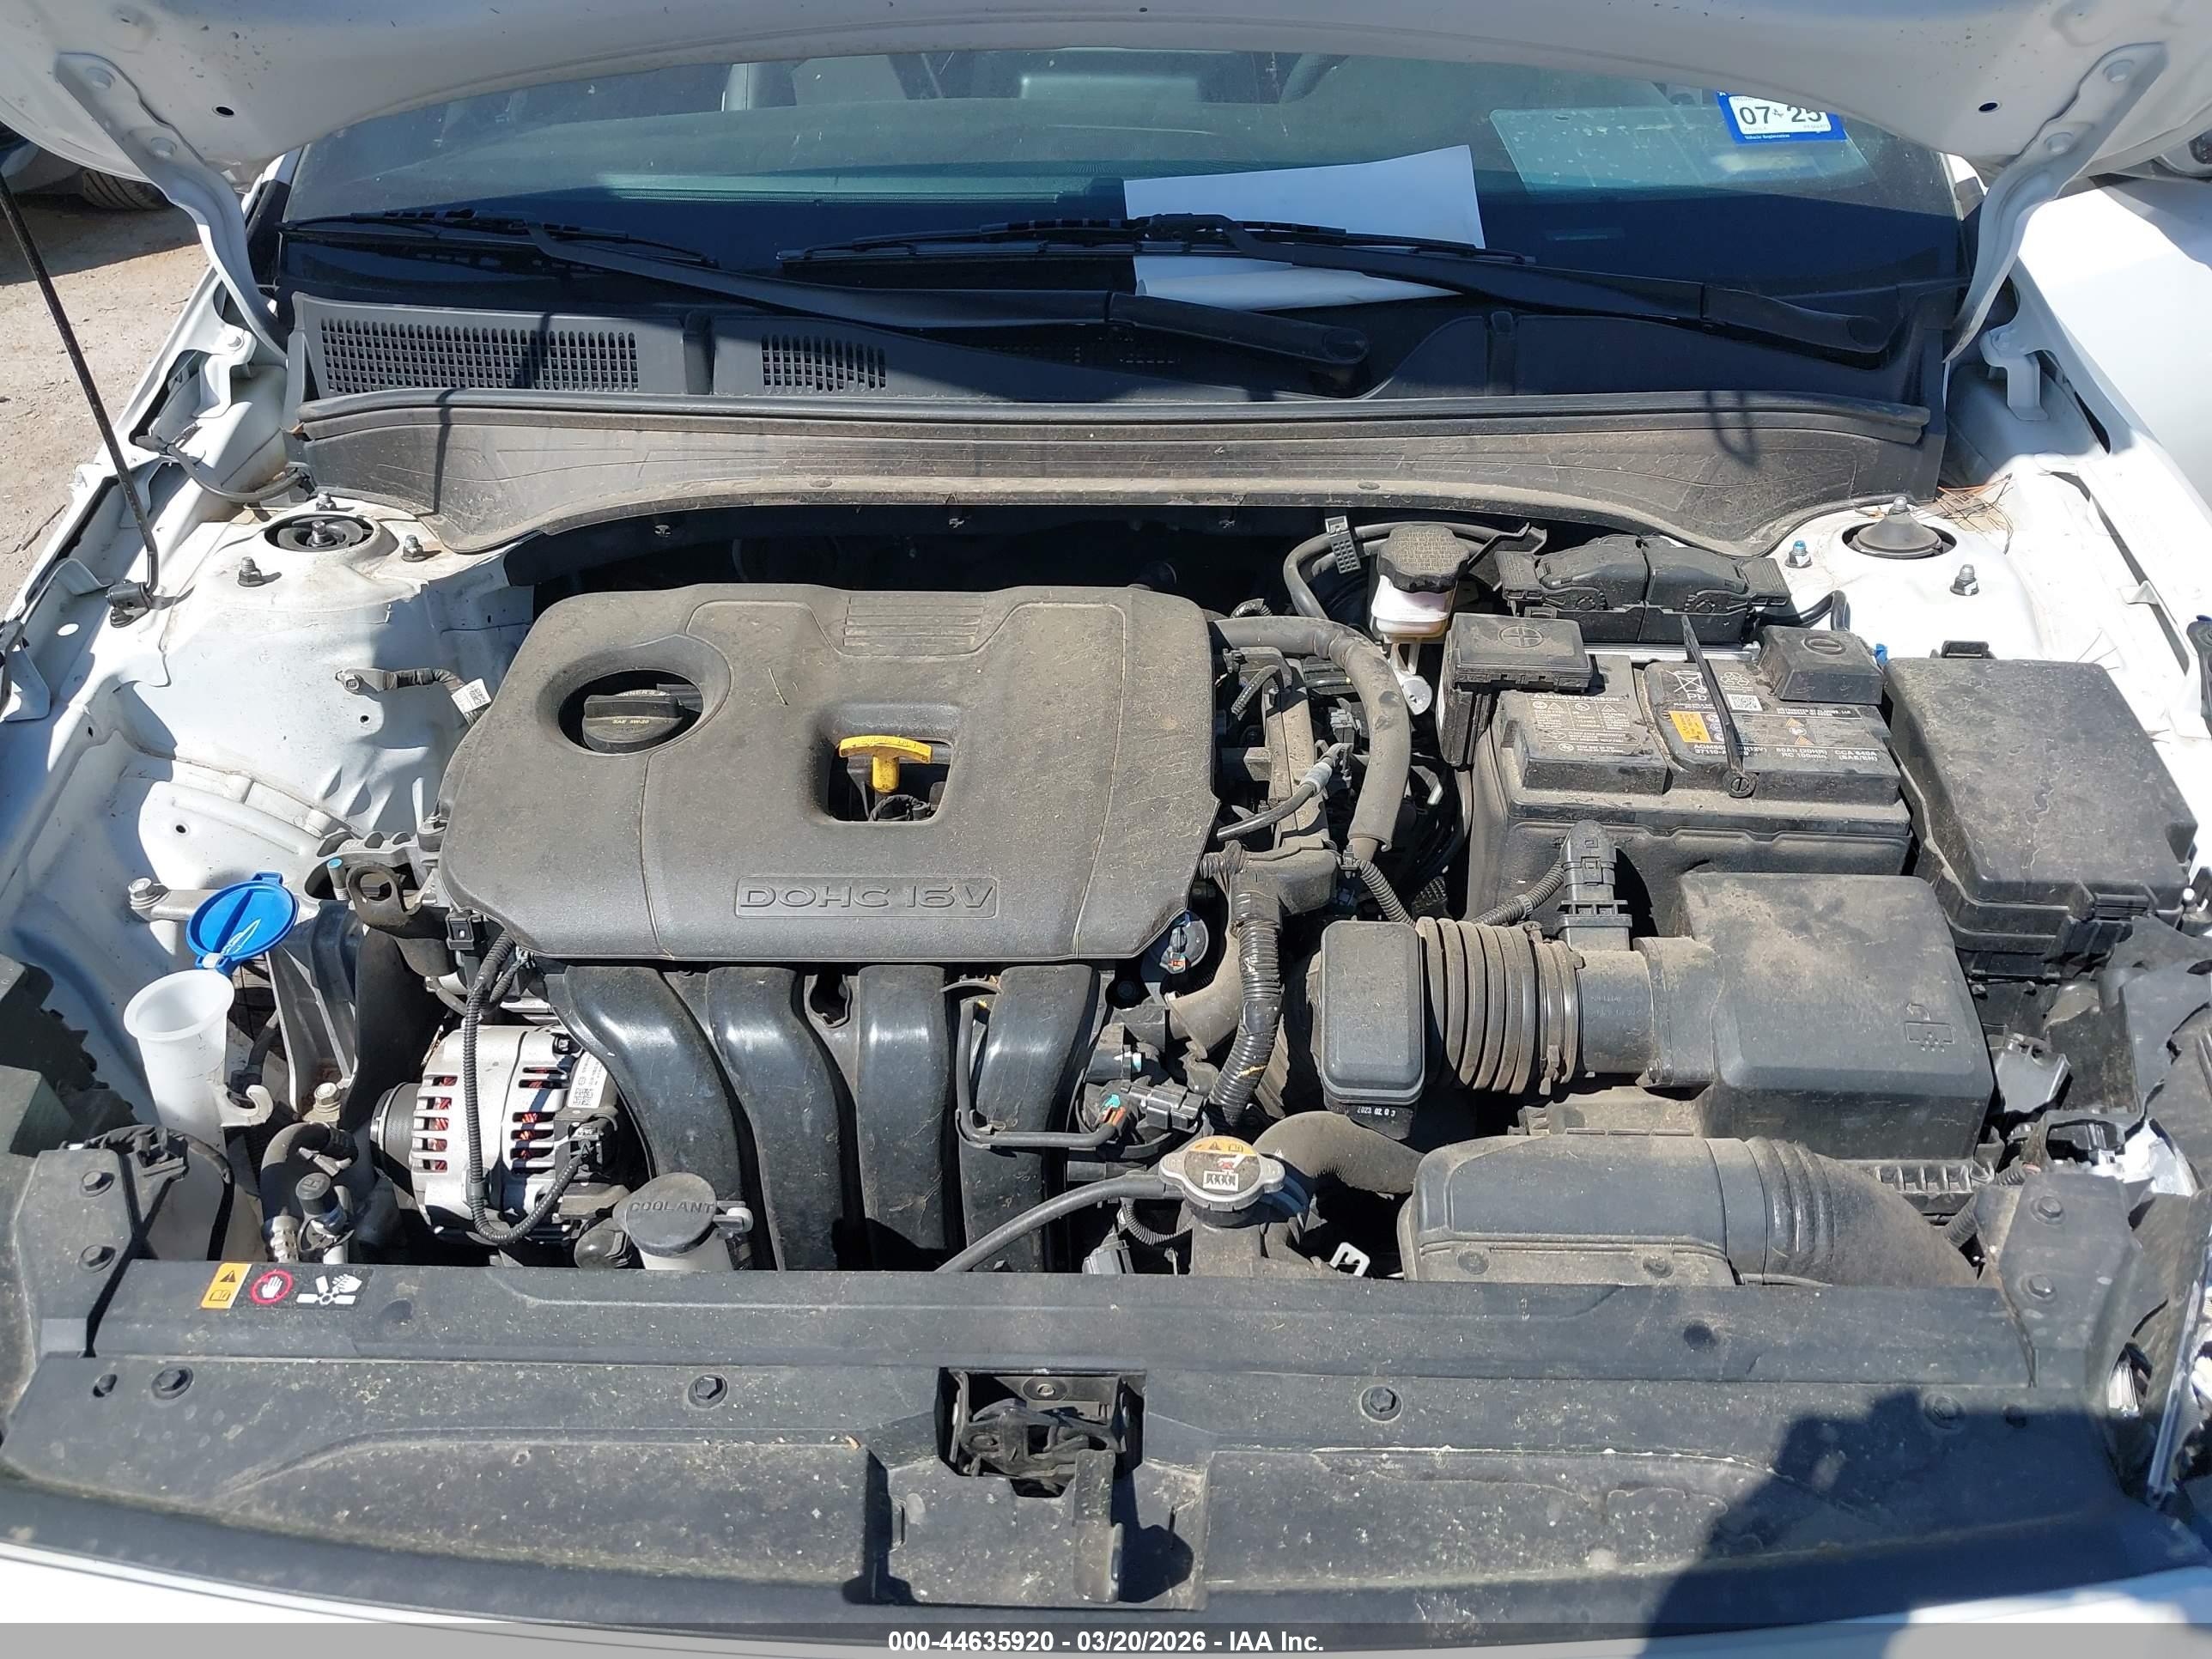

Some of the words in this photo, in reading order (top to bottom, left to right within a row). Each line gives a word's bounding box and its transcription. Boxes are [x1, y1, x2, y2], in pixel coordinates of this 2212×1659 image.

[1739, 106, 1770, 125] 07
[1686, 693, 1707, 702] Pb
[740, 884, 890, 908] DOHC
[905, 884, 994, 908] 16V
[629, 1200, 715, 1214] COOLANT
